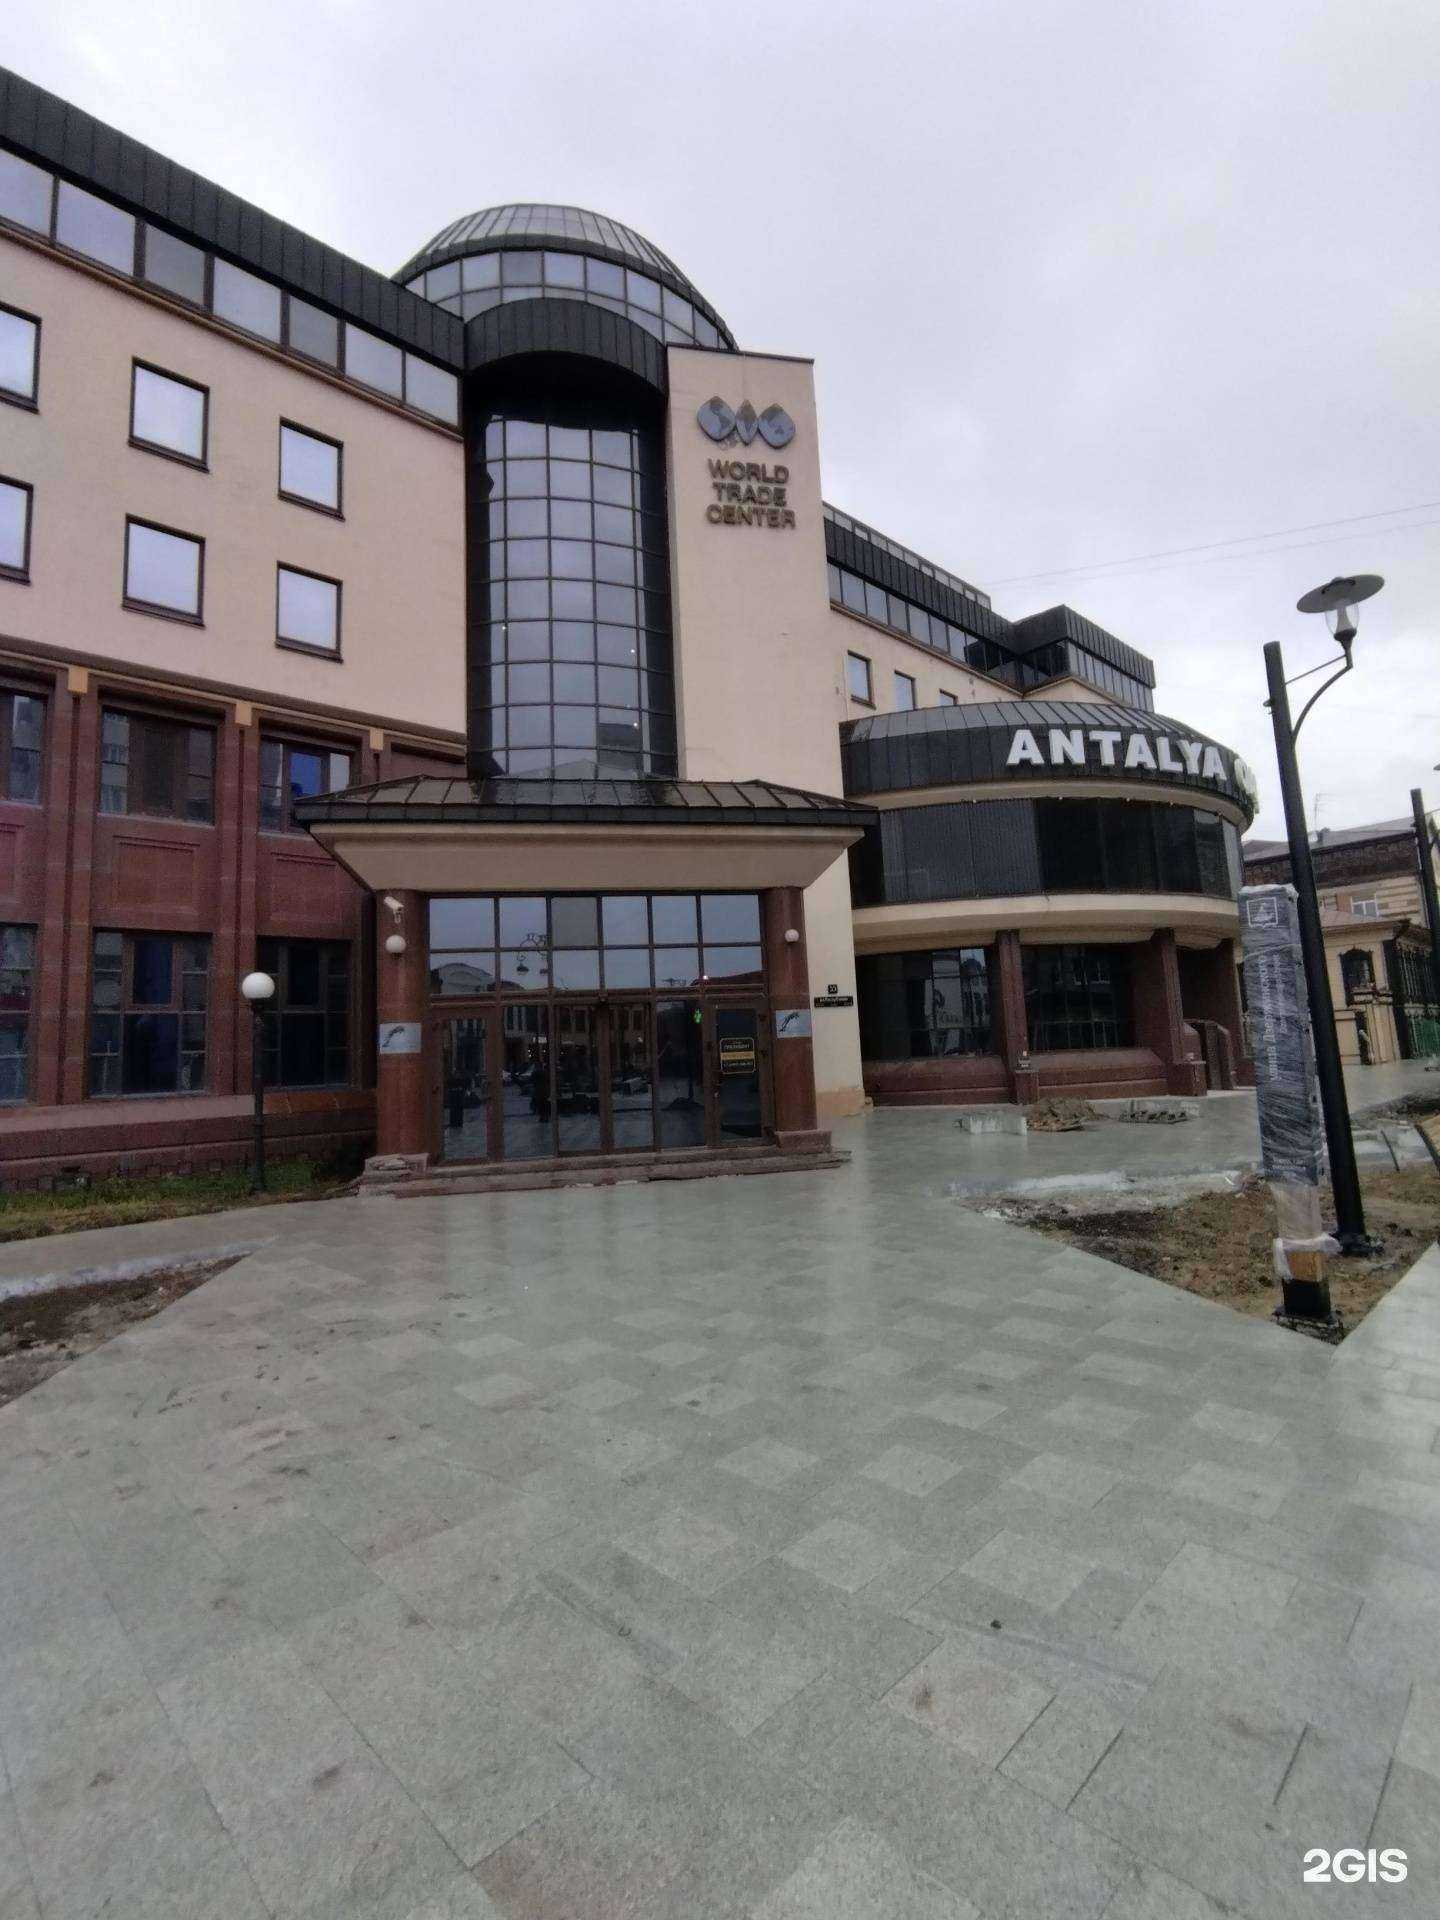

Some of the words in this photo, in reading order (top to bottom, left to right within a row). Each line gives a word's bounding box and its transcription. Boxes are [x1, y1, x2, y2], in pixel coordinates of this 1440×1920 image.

[708, 459, 790, 484] WORLD
[713, 482, 788, 506] TRADE
[706, 503, 796, 530] CENTER
[1005, 729, 1228, 781] ANTALYA
